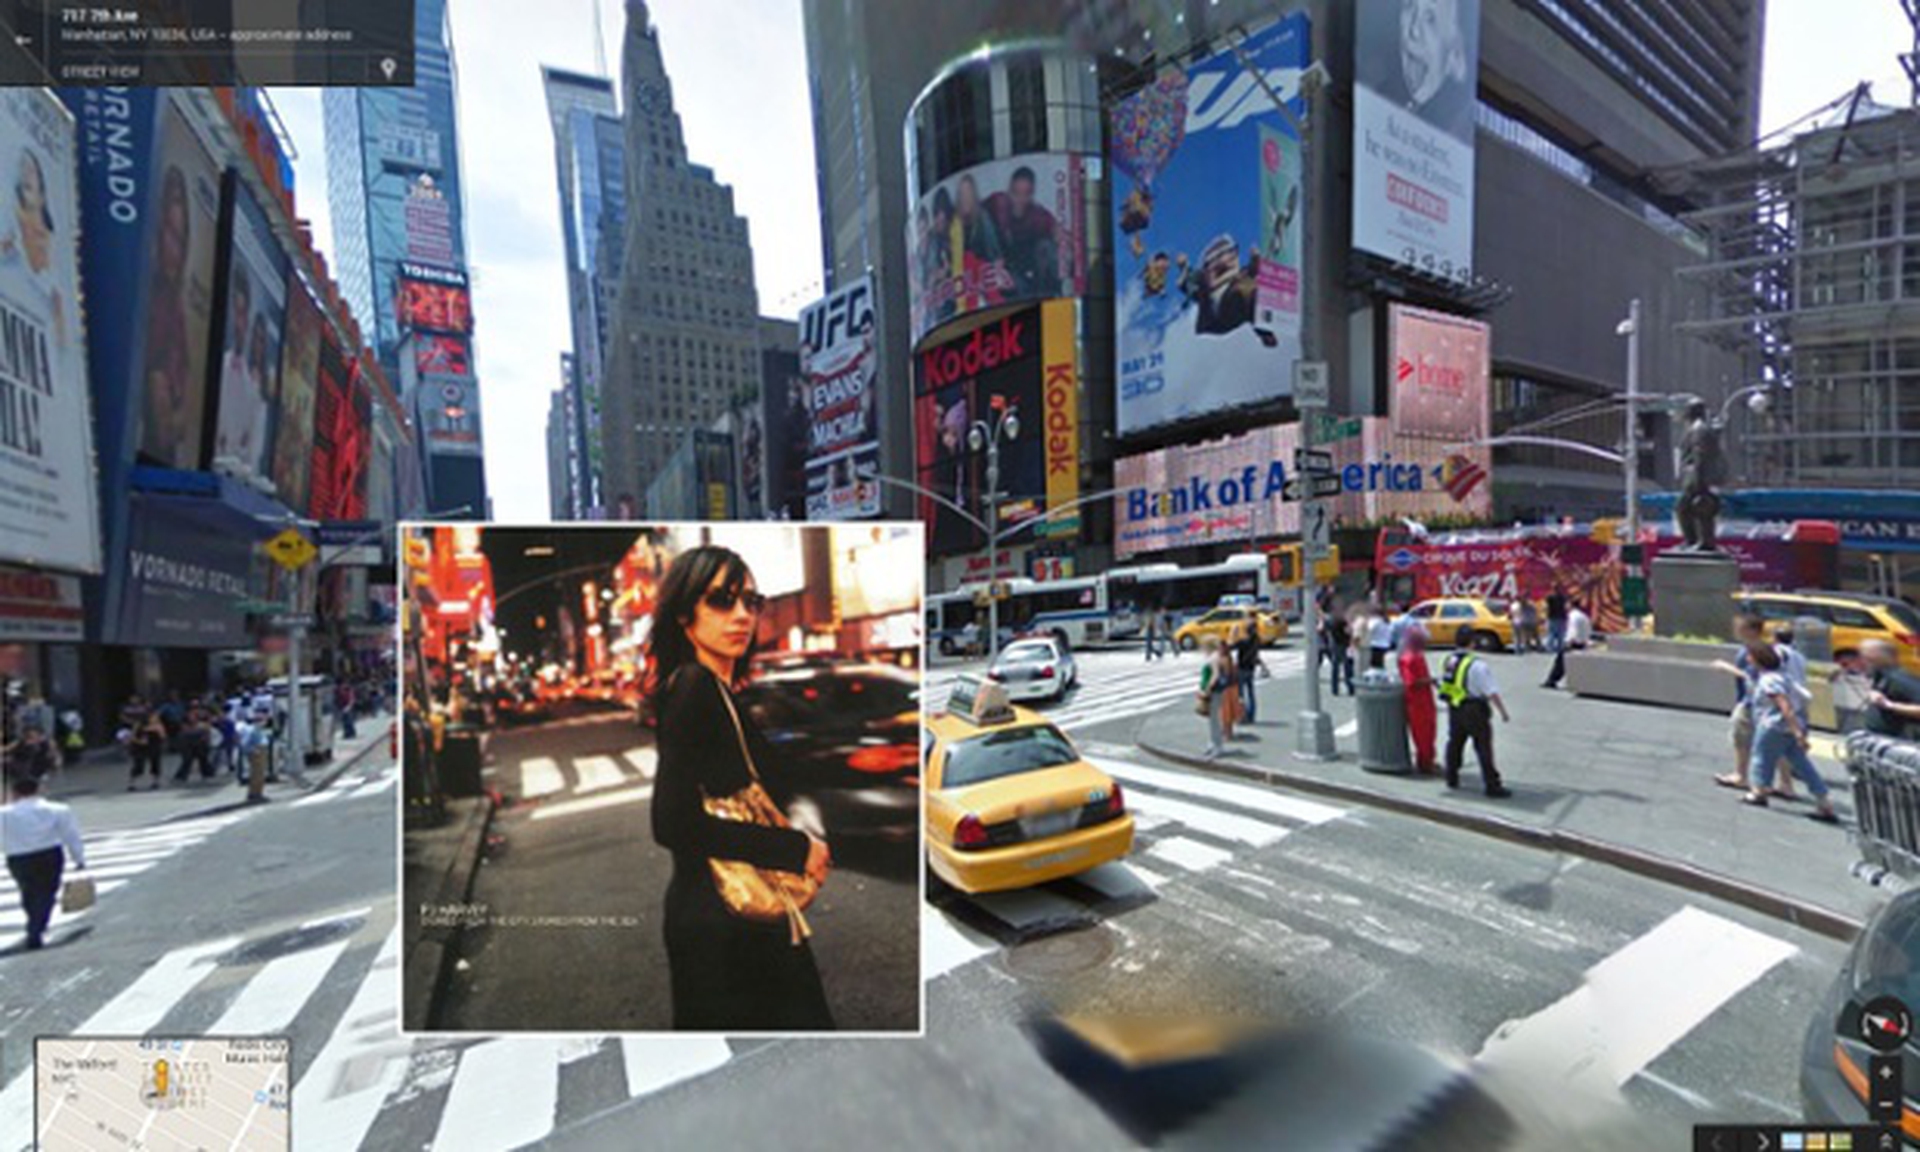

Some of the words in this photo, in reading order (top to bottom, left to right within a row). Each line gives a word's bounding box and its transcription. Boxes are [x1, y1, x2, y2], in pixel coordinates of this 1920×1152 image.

[1185, 67, 1303, 134] UP
[402, 262, 467, 286] TOSHIBA
[804, 284, 874, 355] UFC
[923, 316, 1024, 388] Kodak
[813, 369, 863, 412] EVANS
[1046, 362, 1074, 477] Kodak
[1128, 474, 1213, 521] Bank
[1217, 465, 1258, 507] of
[1263, 452, 1423, 500] Aerica
[129, 549, 204, 589] VORNADO
[206, 567, 251, 599] RETAIL
[1422, 552, 1467, 564] CIRQUE
[1469, 553, 1490, 563] DU
